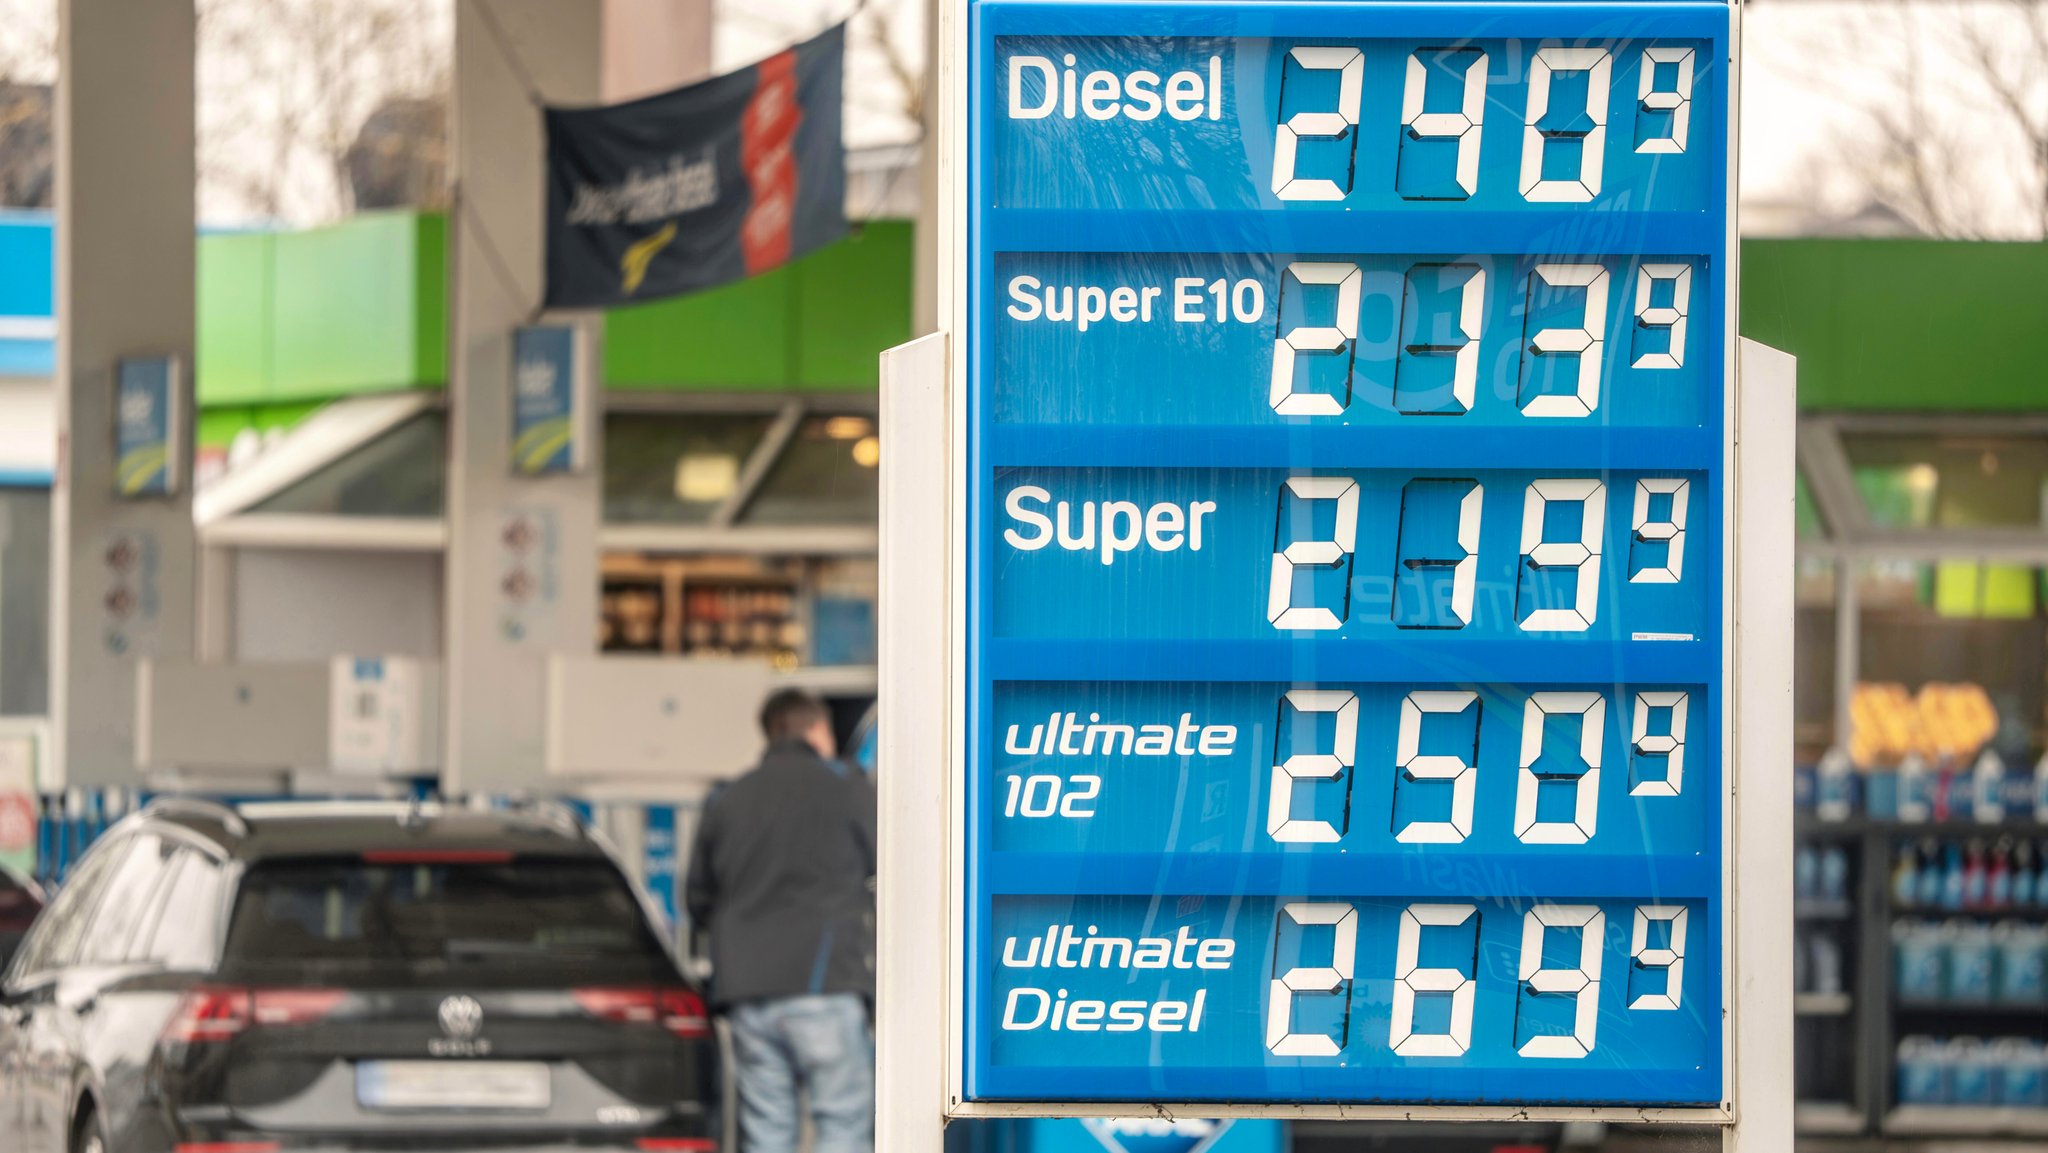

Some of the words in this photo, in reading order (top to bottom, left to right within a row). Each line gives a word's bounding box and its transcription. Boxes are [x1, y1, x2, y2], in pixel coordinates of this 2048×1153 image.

[1008, 54, 1222, 122] Diesel
[1007, 275, 1162, 332] Super
[1173, 277, 1265, 324] E10
[1003, 485, 1218, 566] Super
[1004, 712, 1238, 756] ultimate
[1004, 774, 1102, 818] 102
[1002, 924, 1236, 970] ultimate
[1001, 987, 1207, 1032] Diesel
